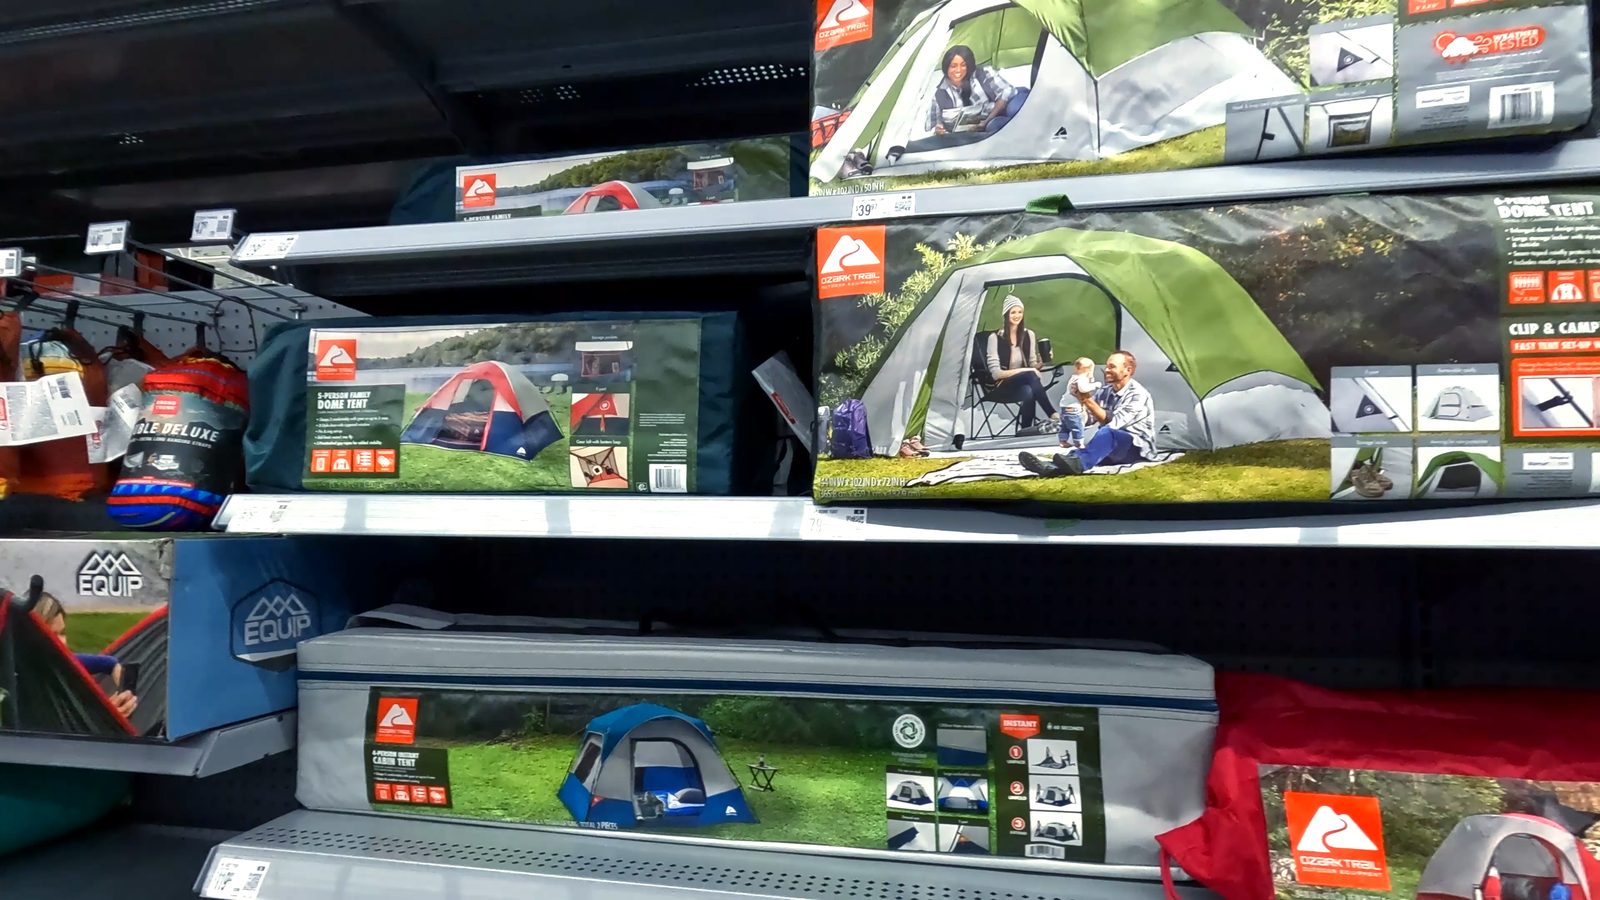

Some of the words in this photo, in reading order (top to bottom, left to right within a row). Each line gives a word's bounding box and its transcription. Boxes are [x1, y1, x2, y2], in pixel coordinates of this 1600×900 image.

[818, 27, 846, 39] OZARK
[846, 21, 869, 32] TRAIL
[1492, 29, 1539, 41] WEATHER
[1493, 35, 1539, 51] TESTED
[1497, 204, 1551, 219] DOME
[1549, 201, 1594, 217] TENT
[821, 275, 851, 285] OZARK
[853, 272, 880, 280] TRAIL
[1508, 323, 1540, 336] CLIP
[1542, 322, 1556, 335] &
[1558, 321, 1600, 334] CAMP
[1514, 342, 1537, 351] FAST
[317, 391, 349, 400] 5-PERSON
[349, 391, 372, 399] FAMILY
[317, 399, 345, 410] DOME
[346, 398, 369, 409] TENT
[161, 422, 220, 442] DELUXE
[78, 575, 143, 598] EQUIP
[243, 614, 312, 647] EQUIP
[1002, 719, 1038, 728] INSTANT
[372, 755, 396, 766] CABIN
[396, 757, 417, 768] TENT
[1299, 855, 1343, 867] OZARK
[1343, 859, 1383, 871] TRAIL
